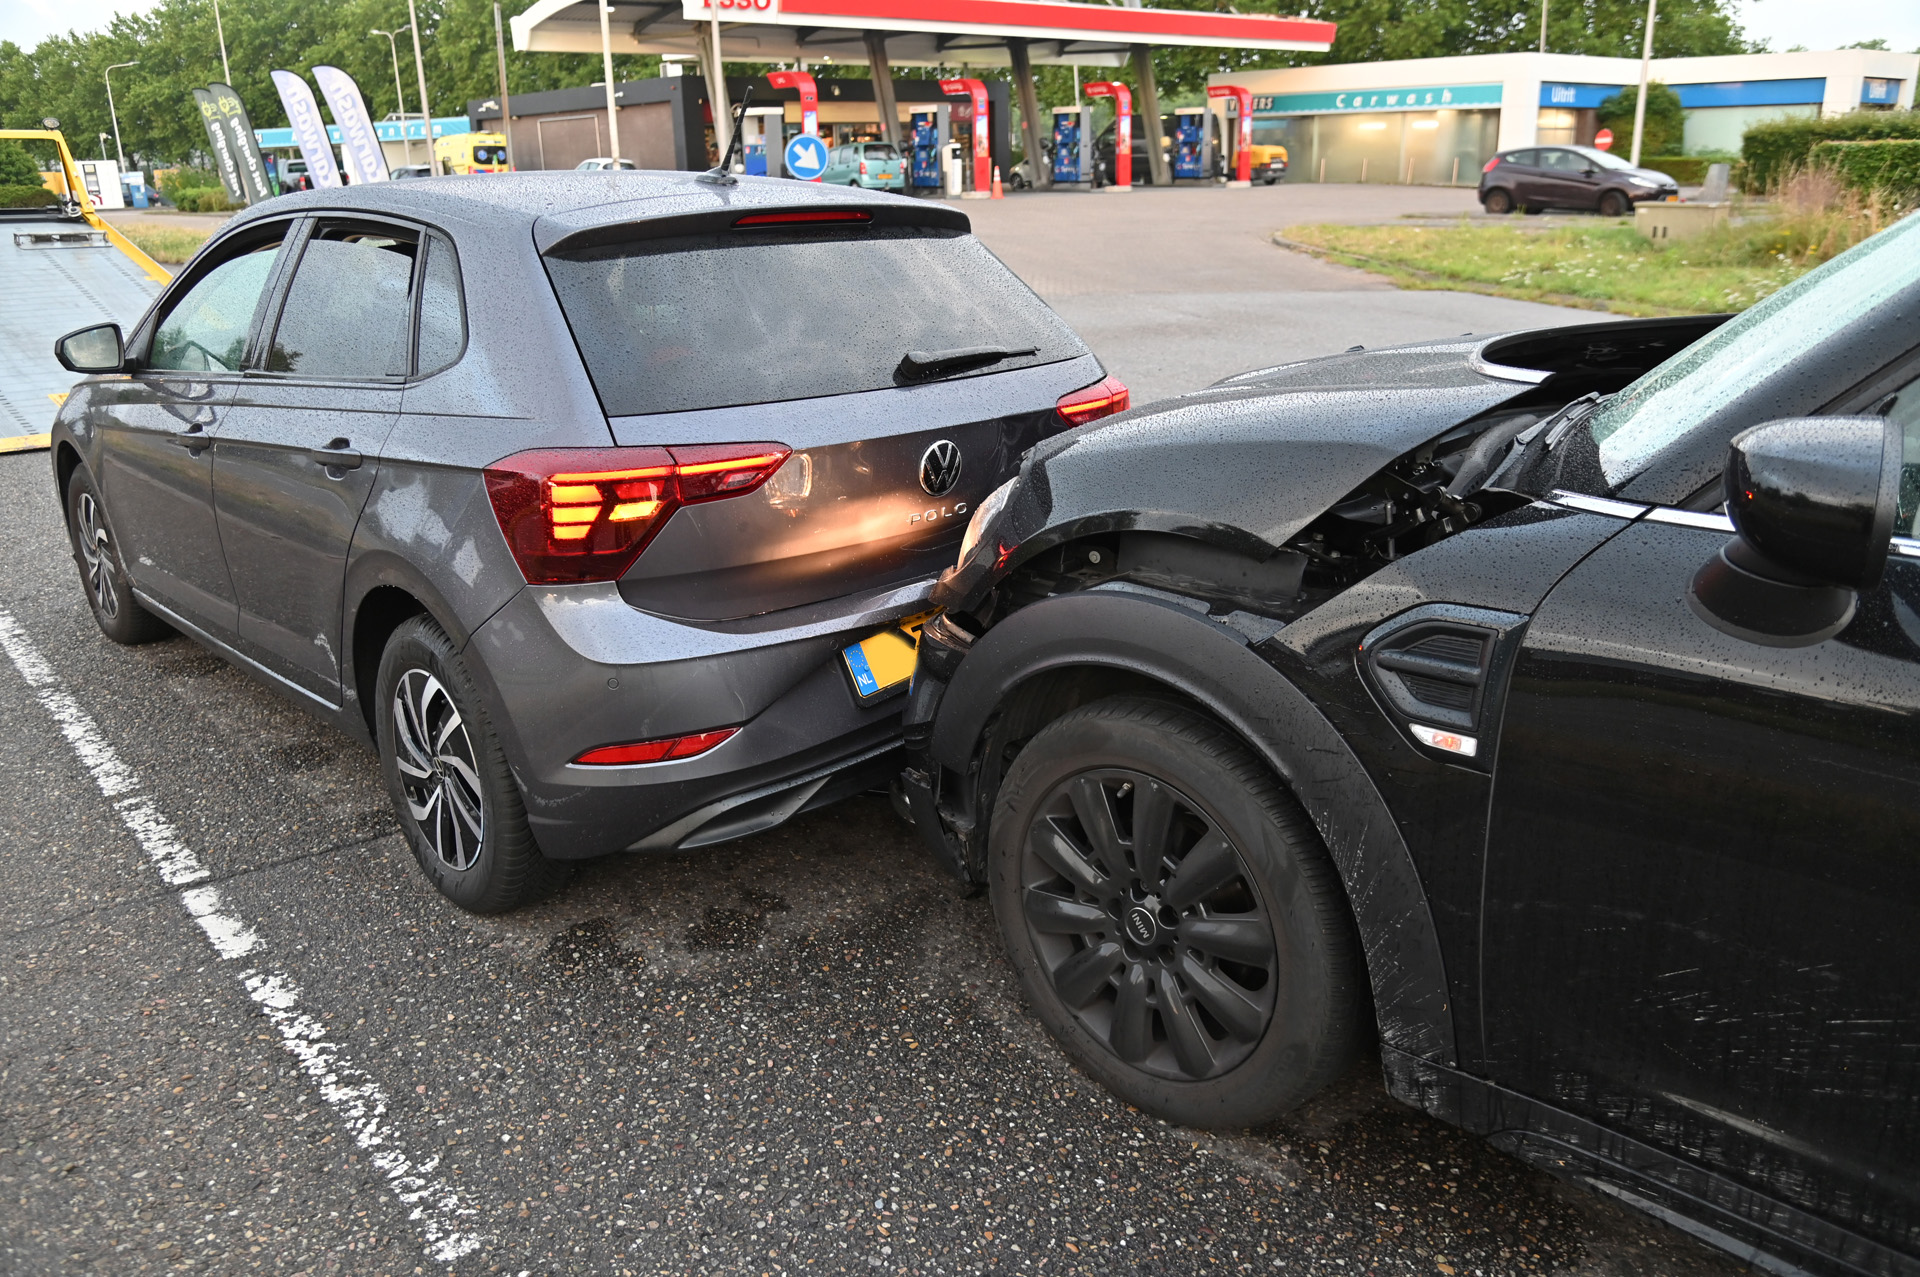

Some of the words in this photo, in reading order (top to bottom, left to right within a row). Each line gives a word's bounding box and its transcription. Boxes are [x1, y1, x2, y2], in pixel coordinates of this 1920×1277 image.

[1336, 88, 1452, 108] Carwash
[909, 502, 968, 526] POLO
[857, 673, 873, 687] NL
[1131, 912, 1150, 939] MINI
